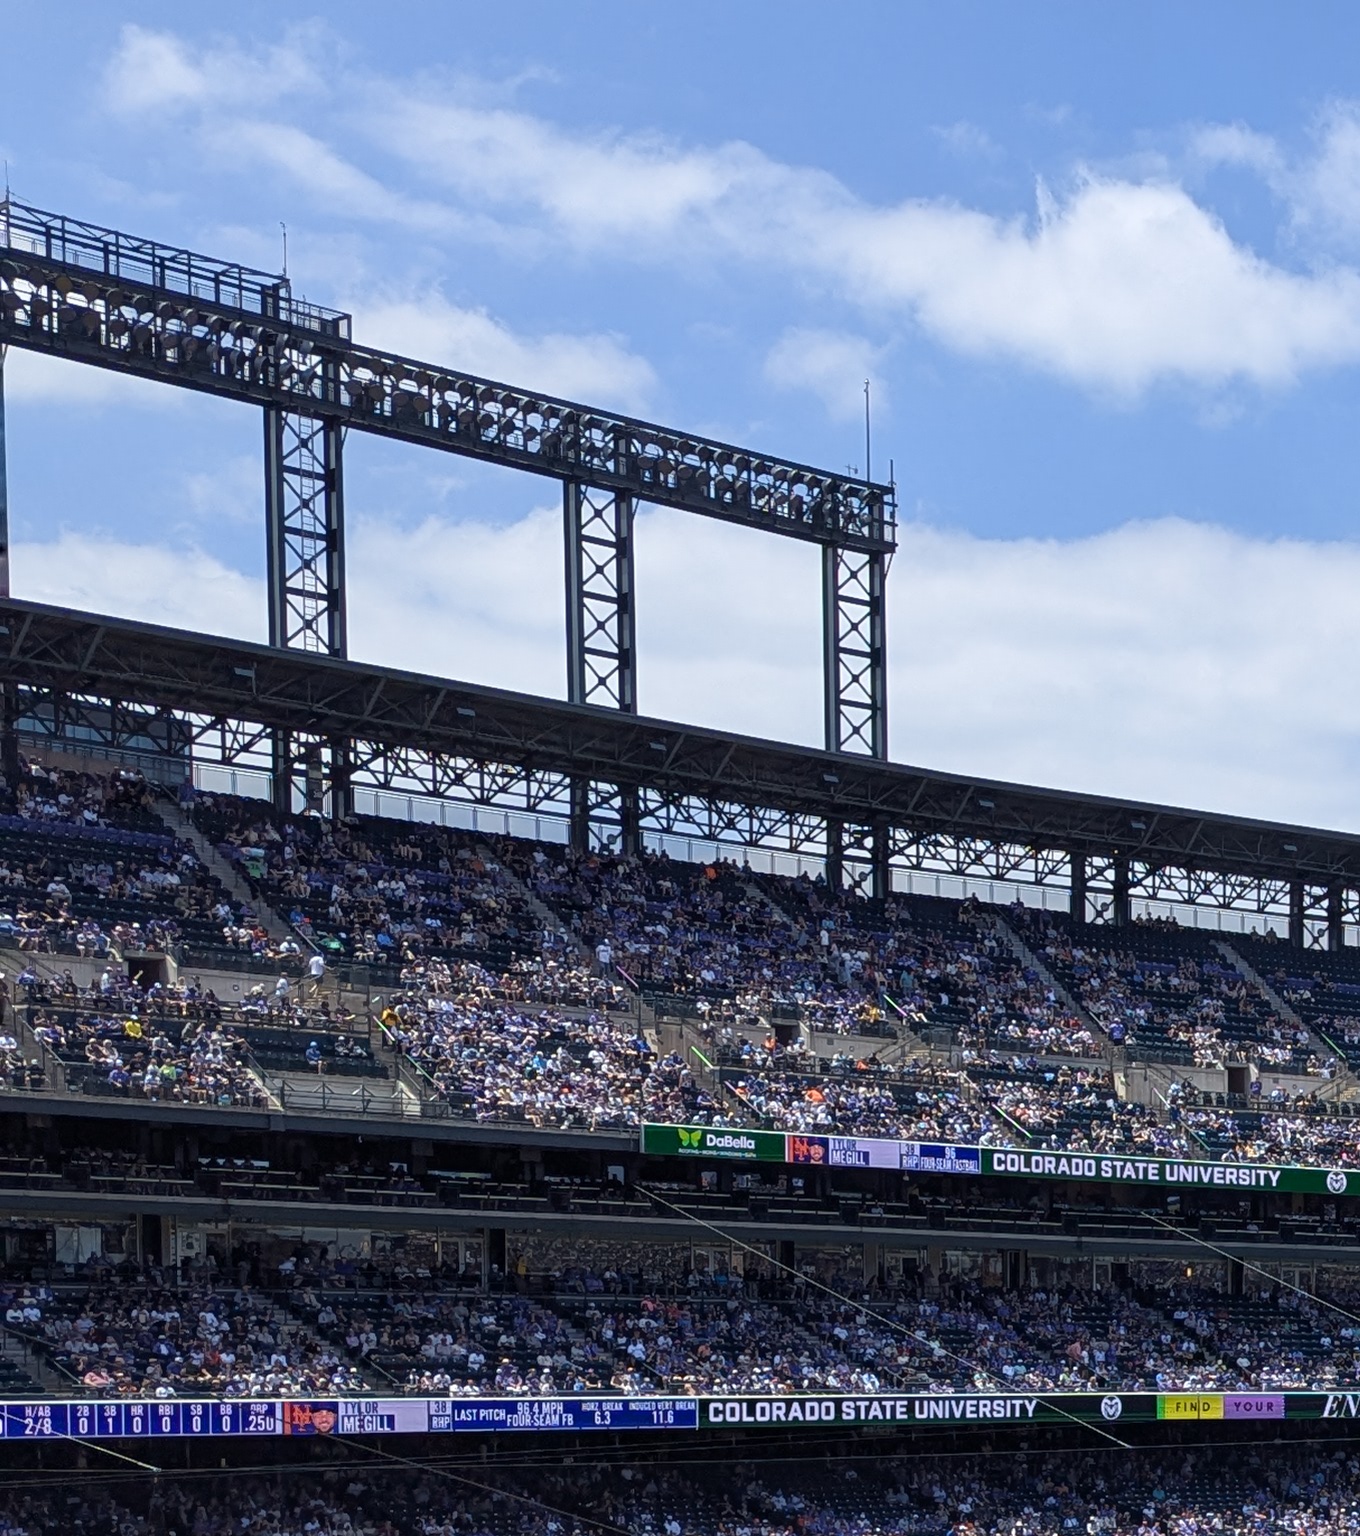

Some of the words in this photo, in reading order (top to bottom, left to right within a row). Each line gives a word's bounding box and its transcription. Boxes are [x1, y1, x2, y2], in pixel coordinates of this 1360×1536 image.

[706, 1133, 756, 1150] DaBella
[832, 1150, 866, 1165] MEGILL
[993, 1152, 1096, 1177] COLORADO
[1100, 1161, 1160, 1181] STATE
[1165, 1164, 1281, 1187] UNIVERSITY
[25, 1405, 51, 1418] H/AB
[517, 1402, 539, 1415] 96.4
[542, 1402, 563, 1415] MPH
[708, 1401, 836, 1423] COLORADO
[841, 1400, 908, 1421] STATE
[914, 1400, 1037, 1420] UNIVERSITY
[1175, 1400, 1211, 1413] FIND
[1234, 1400, 1275, 1412] YOUR
[454, 1409, 479, 1421] LAST
[481, 1408, 506, 1421] PITCH
[507, 1413, 560, 1427] FOUR-SEAM
[594, 1411, 611, 1425] 6.3
[651, 1411, 674, 1424] 11.6
[343, 1415, 391, 1432] MEGILL
